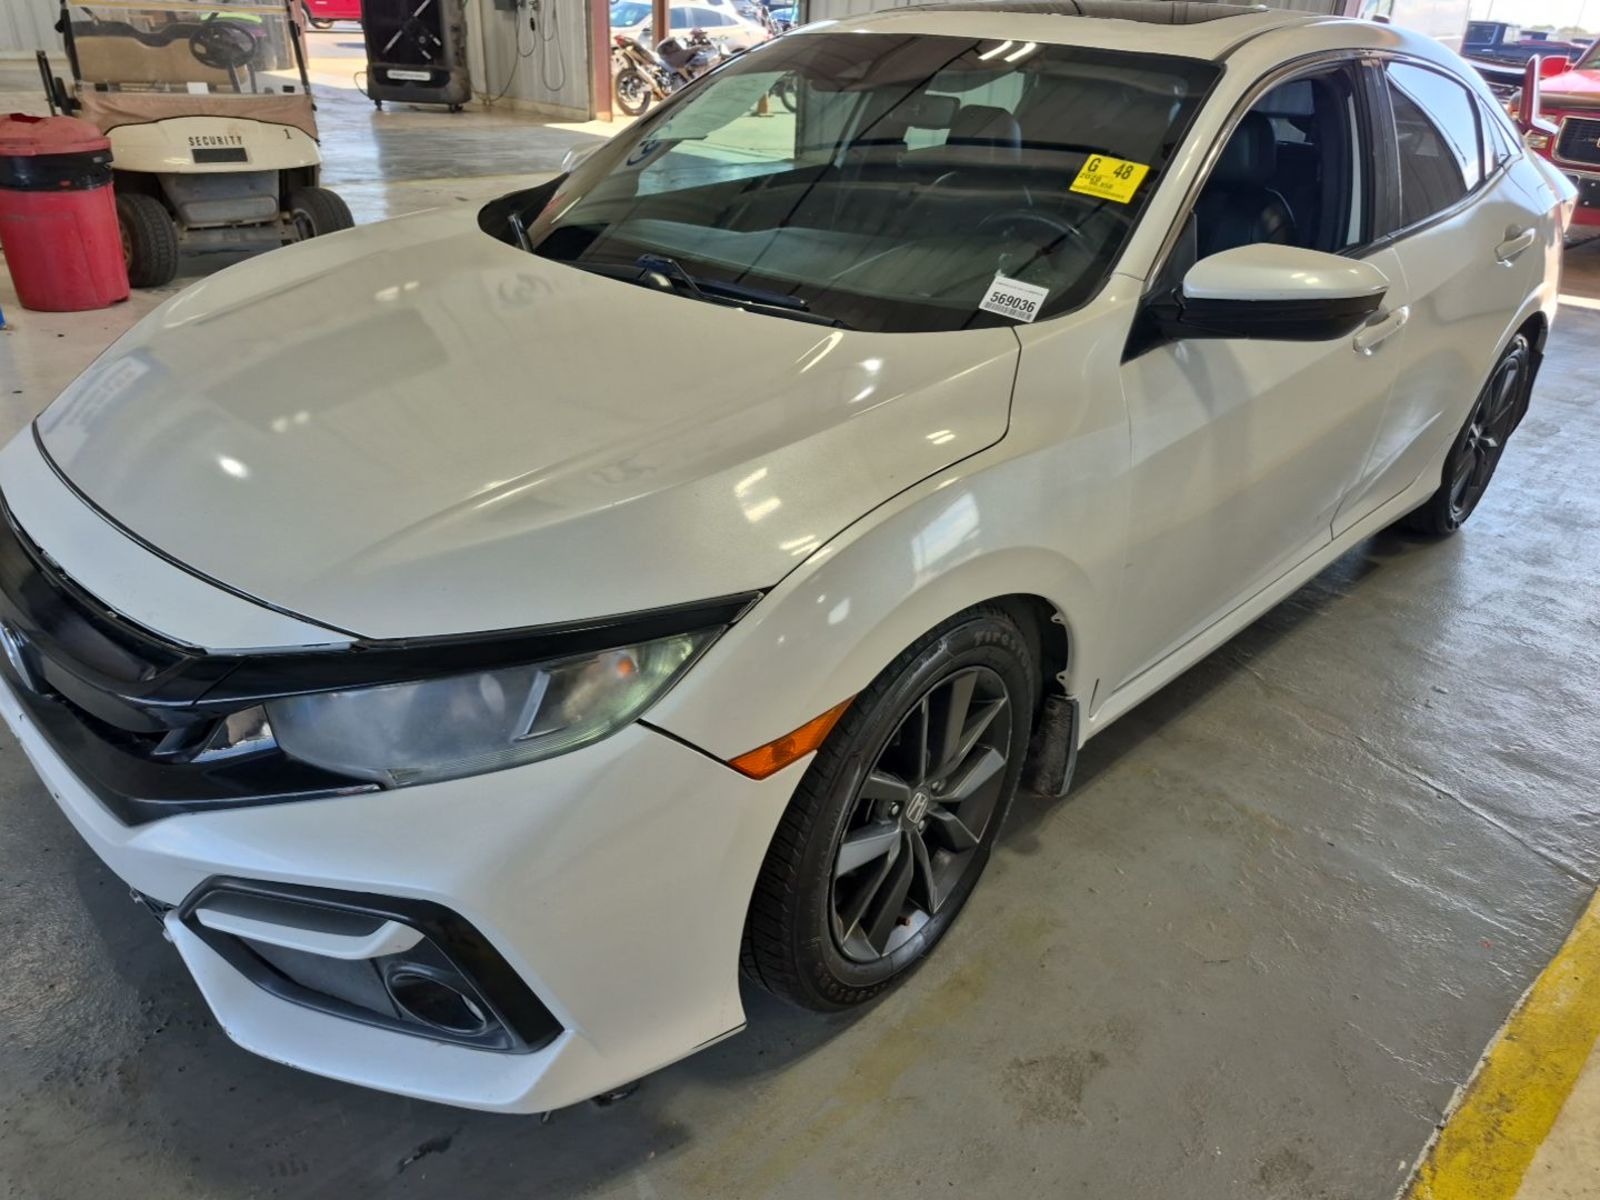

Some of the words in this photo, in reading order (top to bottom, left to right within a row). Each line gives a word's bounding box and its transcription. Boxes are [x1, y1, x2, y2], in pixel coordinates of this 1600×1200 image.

[188, 135, 242, 146] SECURITY
[283, 128, 292, 140] 1
[1088, 157, 1102, 172] G
[1113, 163, 1134, 180] 48
[990, 291, 1037, 313] 569036
